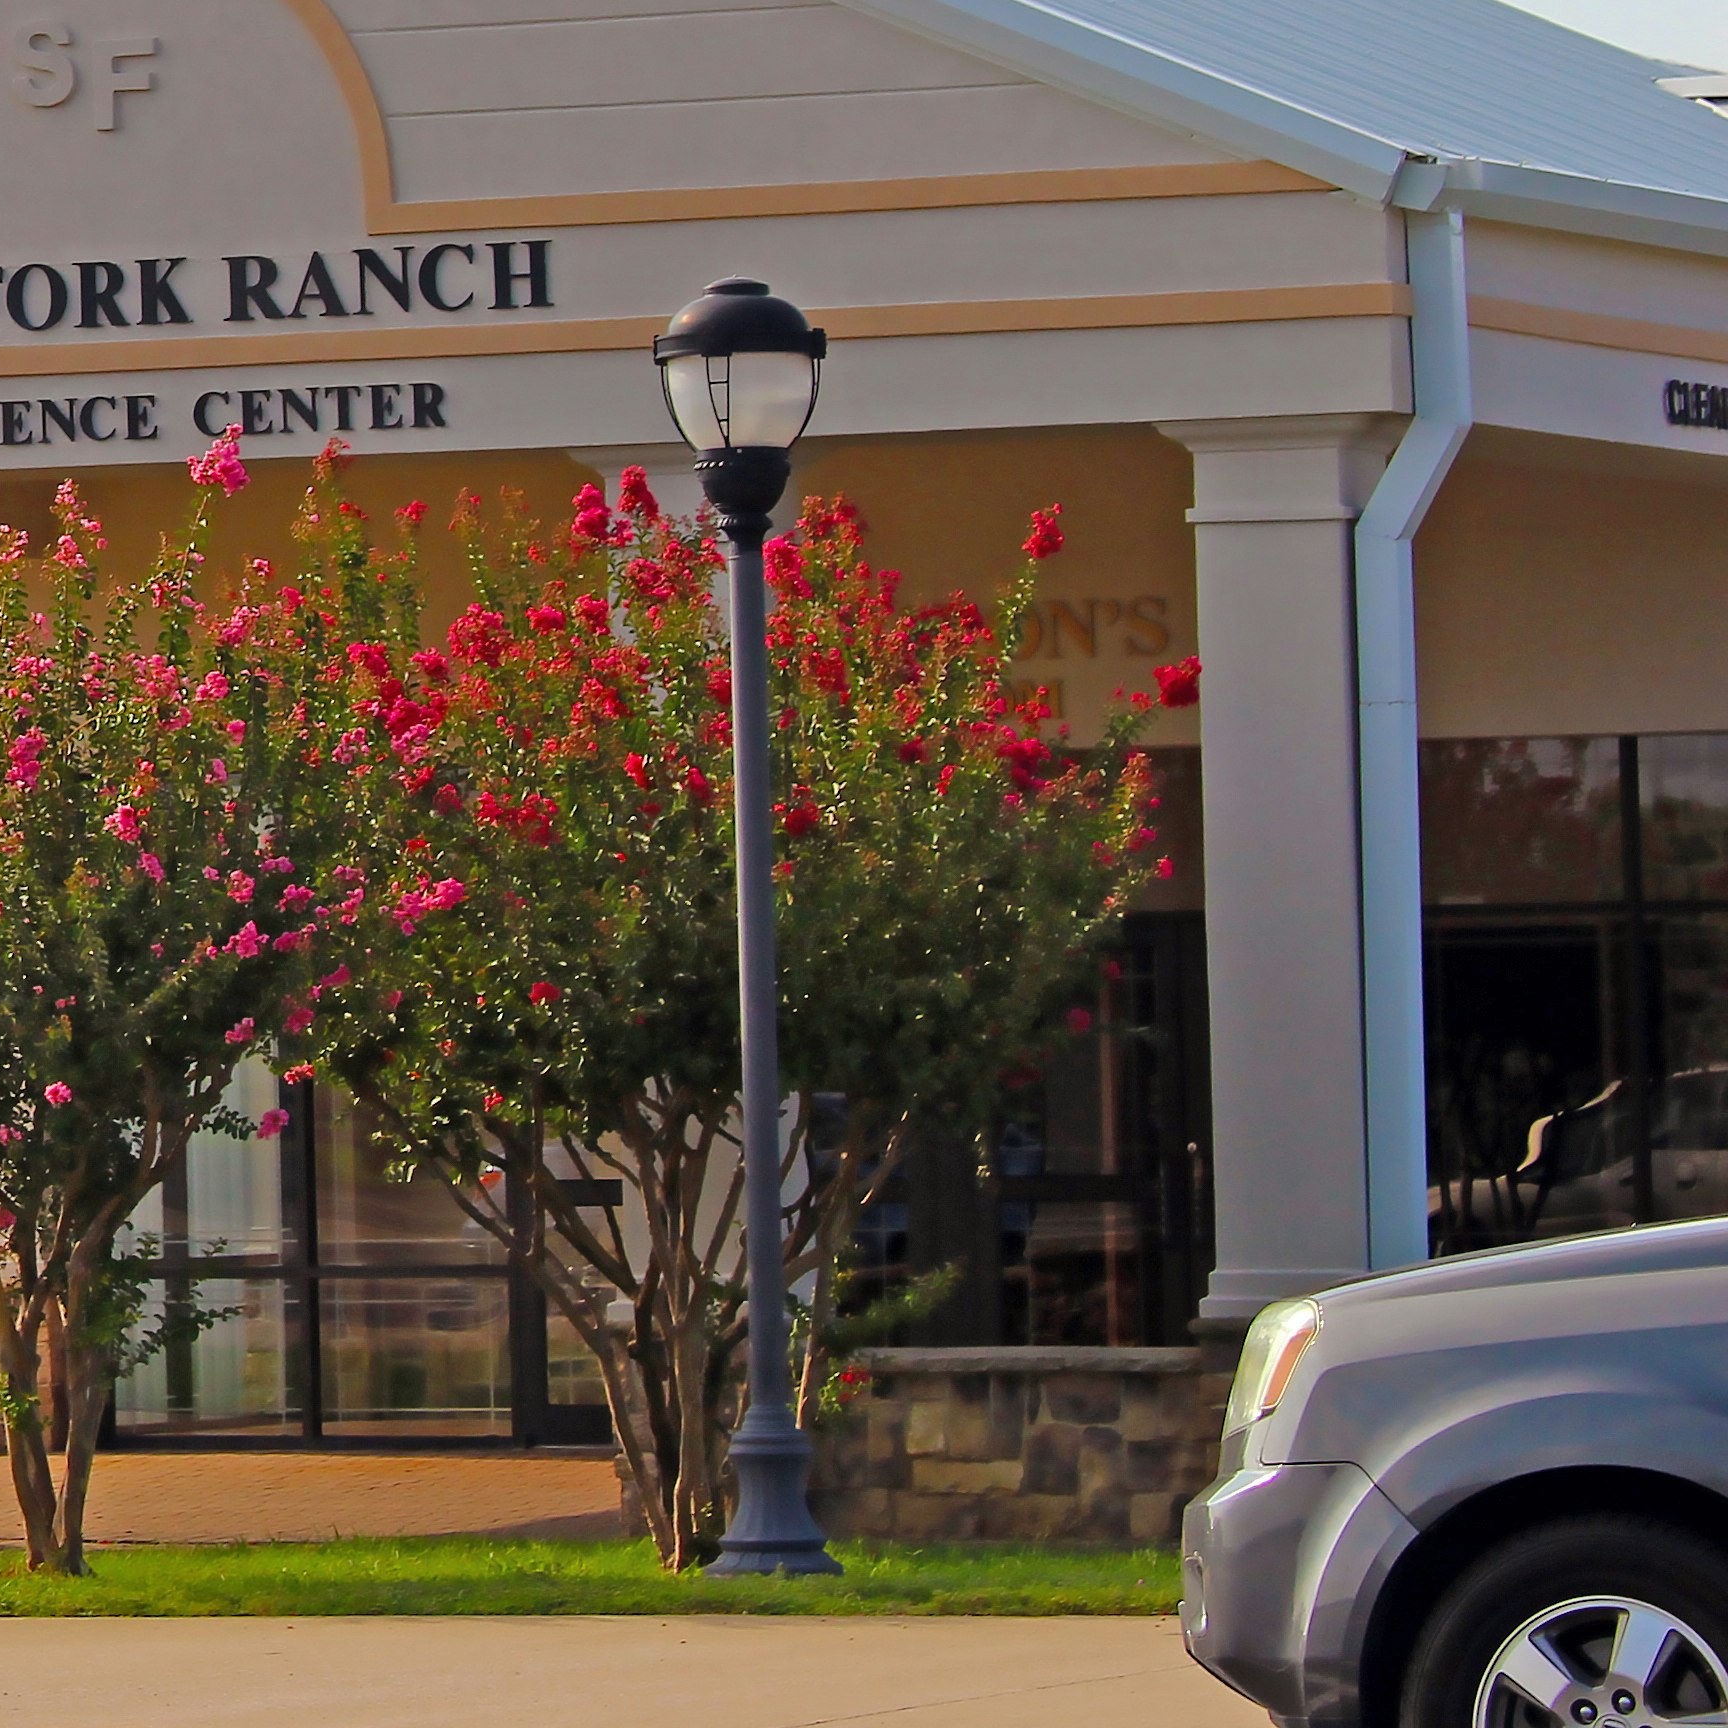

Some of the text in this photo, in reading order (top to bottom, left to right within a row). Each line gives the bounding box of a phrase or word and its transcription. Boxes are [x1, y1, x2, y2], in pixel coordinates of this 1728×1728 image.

[12, 19, 160, 132] SF
[221, 239, 555, 322] RANCH
[193, 382, 446, 438] CENTER
